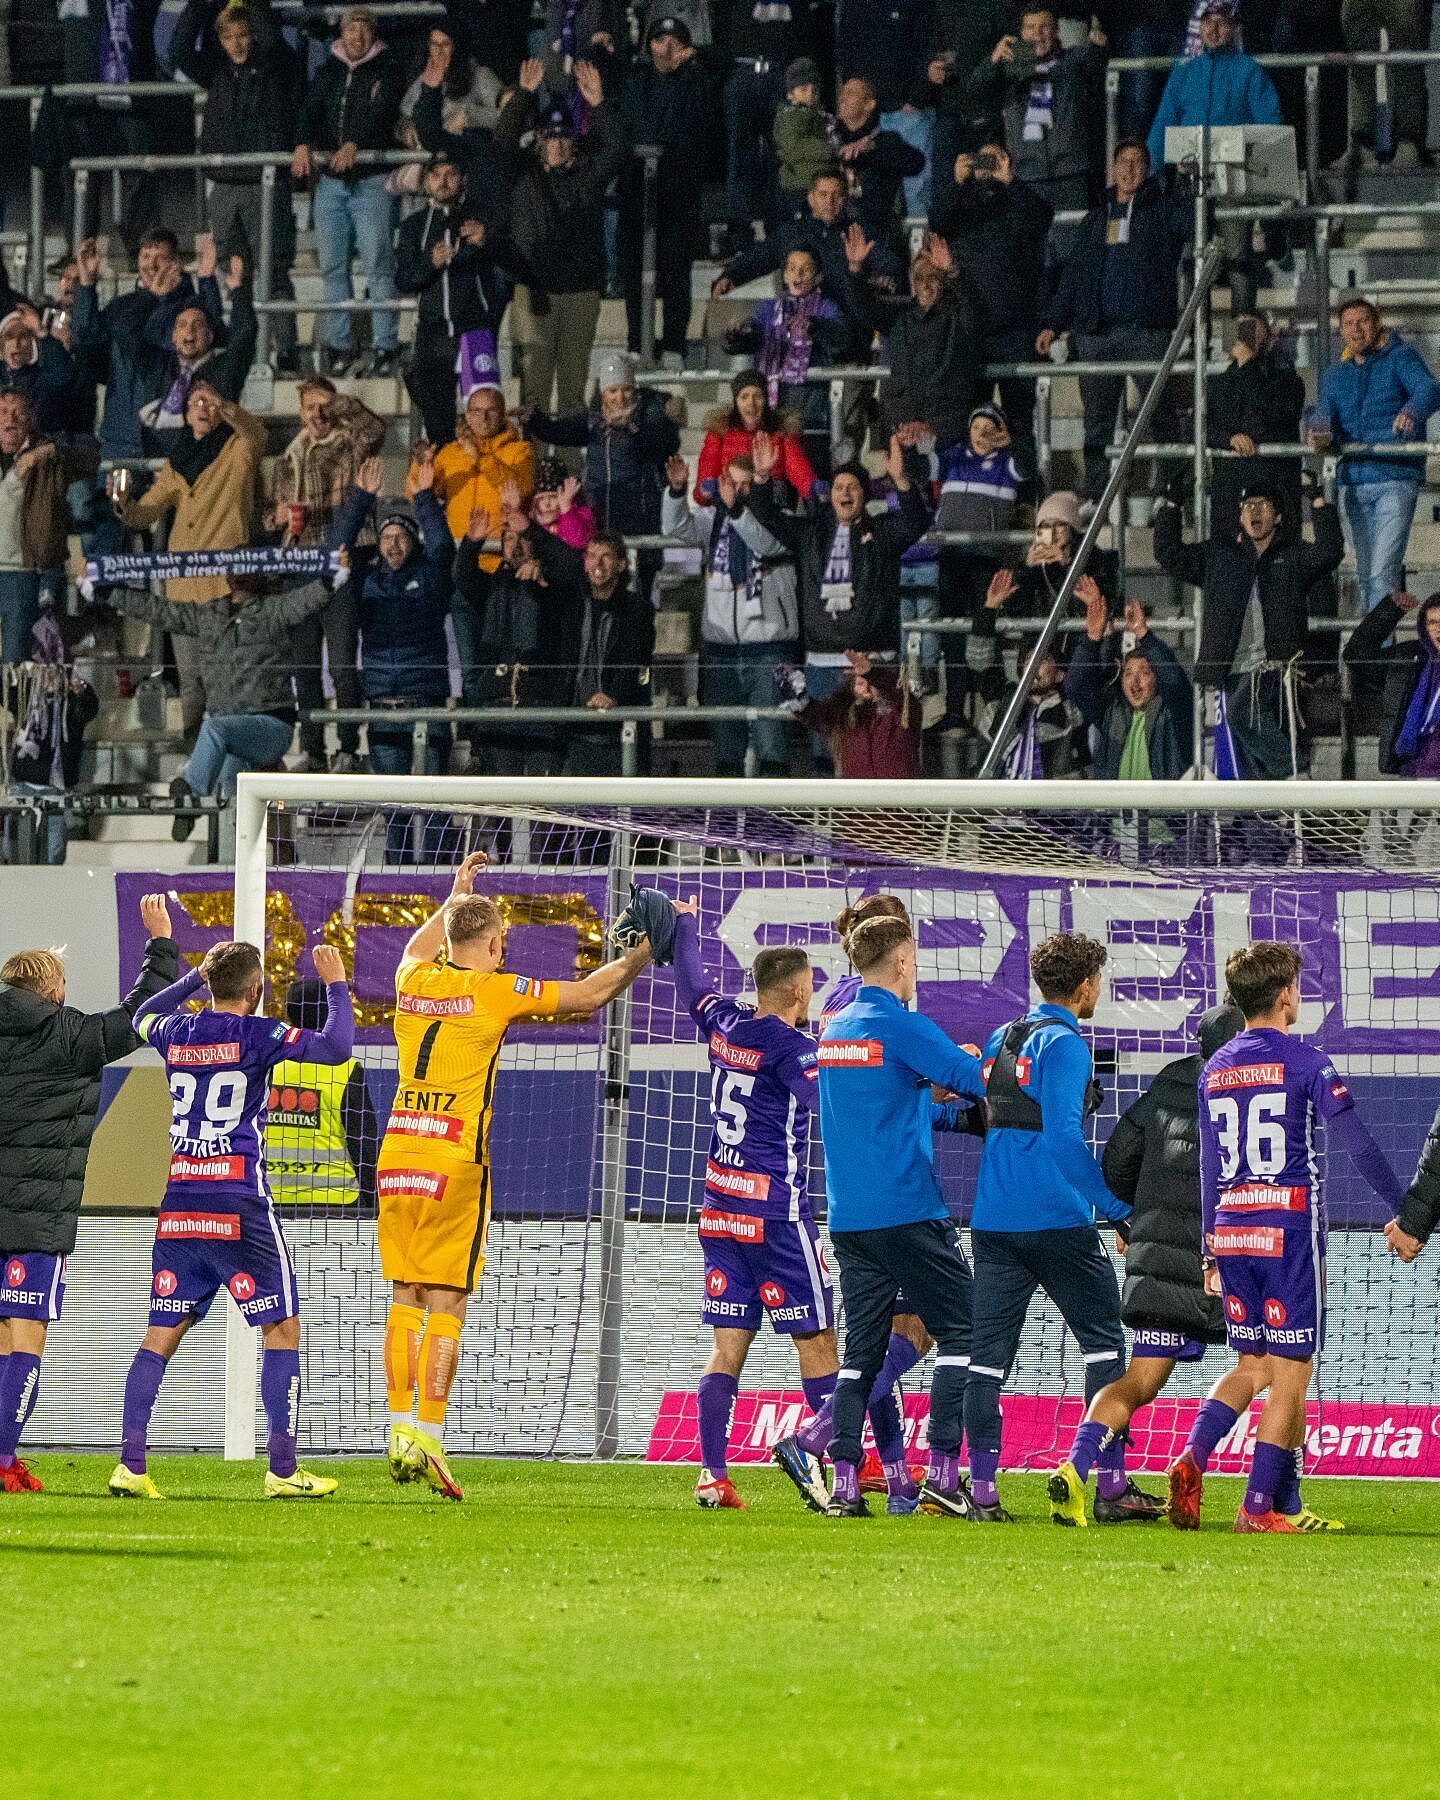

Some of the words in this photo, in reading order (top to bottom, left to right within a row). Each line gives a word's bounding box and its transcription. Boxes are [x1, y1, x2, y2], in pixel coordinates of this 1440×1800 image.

[716, 886, 1440, 1036] SPIELE
[411, 997, 473, 1015] GENERALI
[178, 1046, 237, 1062] GENERALI
[413, 1020, 442, 1081] 1
[1221, 1068, 1280, 1086] GENERALI
[169, 1070, 248, 1141] 29
[710, 1066, 756, 1147] 15
[268, 1112, 318, 1126] ECURITAS
[1208, 1092, 1287, 1179] 36
[169, 1135, 233, 1158] UTTNER
[379, 1175, 439, 1193] wienholding
[160, 1218, 233, 1236] wienholding
[1213, 1236, 1275, 1251] ienholding
[0, 1290, 45, 1305] ARSBET
[150, 1299, 198, 1313] ARSBET
[240, 1294, 279, 1316] RSBET
[702, 1300, 748, 1317] ARSBET
[770, 1305, 810, 1322] RSBET
[1264, 1328, 1315, 1344] ARSBET
[15, 1366, 39, 1423] wienholdin
[1215, 1416, 1425, 1460] Maenta
